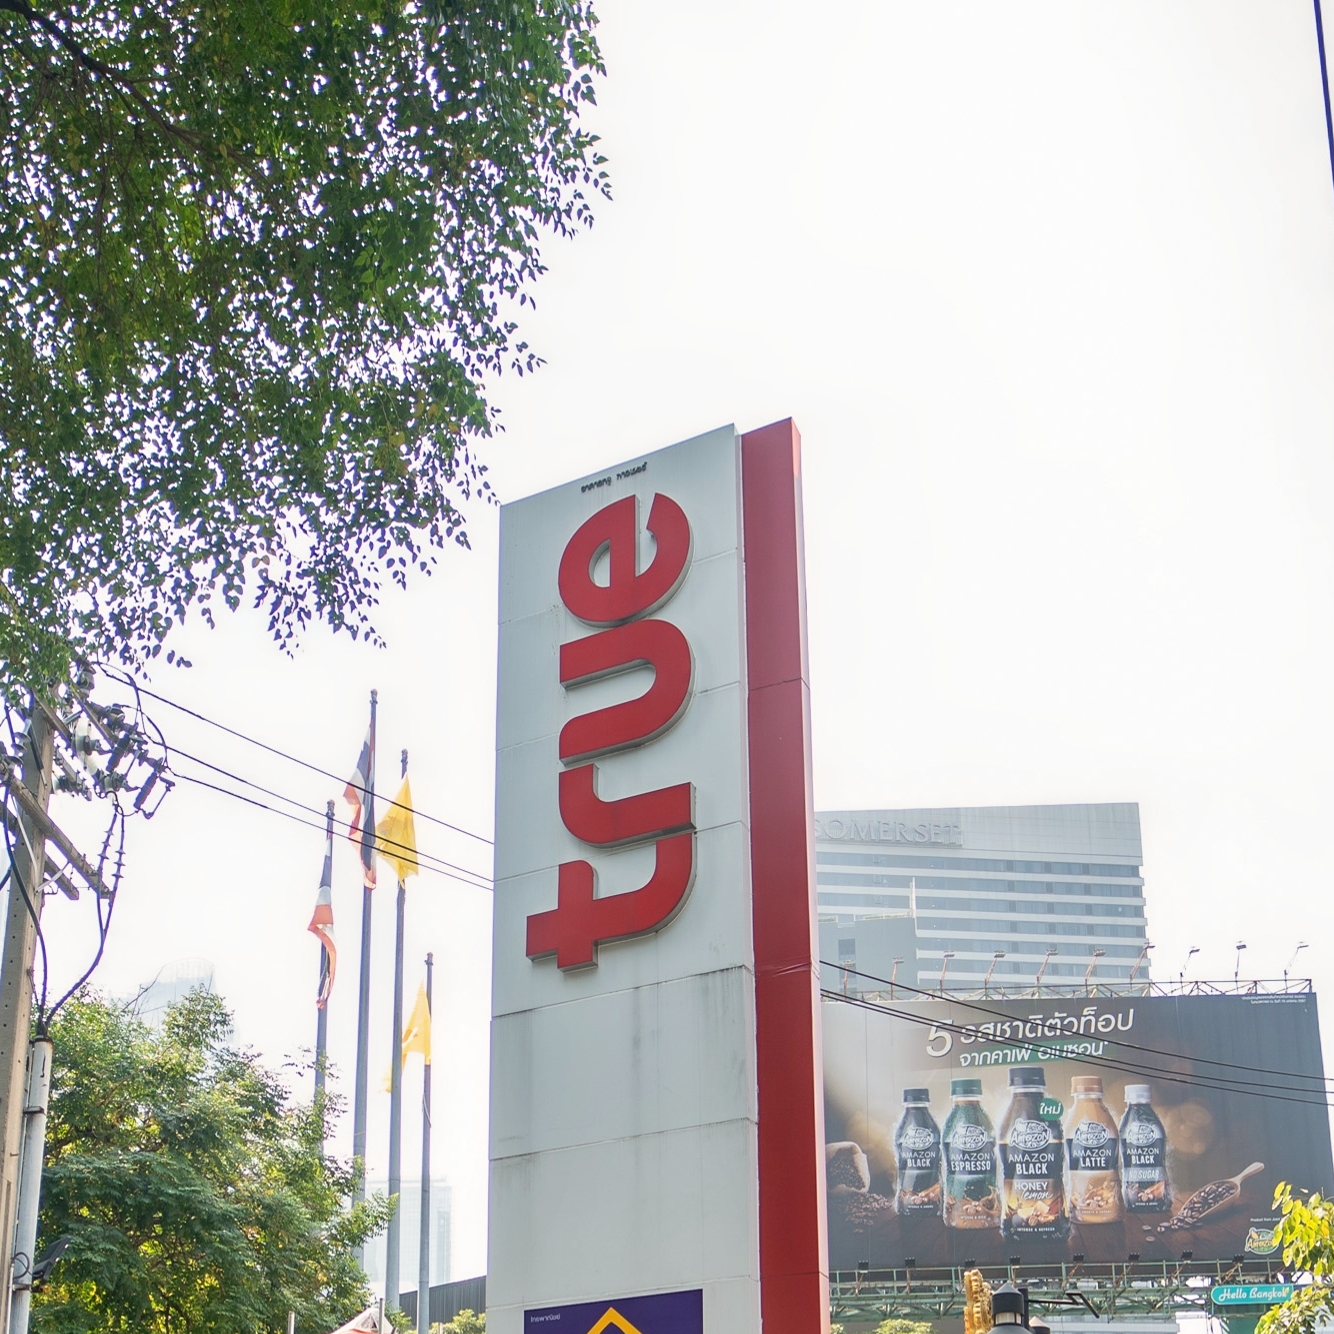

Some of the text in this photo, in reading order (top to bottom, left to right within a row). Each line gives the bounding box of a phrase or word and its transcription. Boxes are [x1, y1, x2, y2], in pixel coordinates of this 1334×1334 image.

[526, 492, 696, 973] true
[814, 819, 963, 846] SOMERSET
[925, 1019, 954, 1057] 5
[960, 1044, 1032, 1067] จากคาเฟ่
[1039, 1102, 1061, 1115] ใหม่
[951, 1152, 990, 1160] AMAZON
[1008, 1153, 1054, 1163] AMAZON
[1073, 1149, 1111, 1157] AMAZON
[907, 1158, 931, 1167] BLACK
[1080, 1157, 1106, 1167] LATTE
[1131, 1155, 1154, 1164] BLACK
[951, 1160, 991, 1171] ESPRESSO
[1016, 1163, 1048, 1175] BLACK
[1139, 1170, 1159, 1179] SUGAR
[1014, 1181, 1048, 1191] HONEY
[1218, 1287, 1247, 1301] Hello
